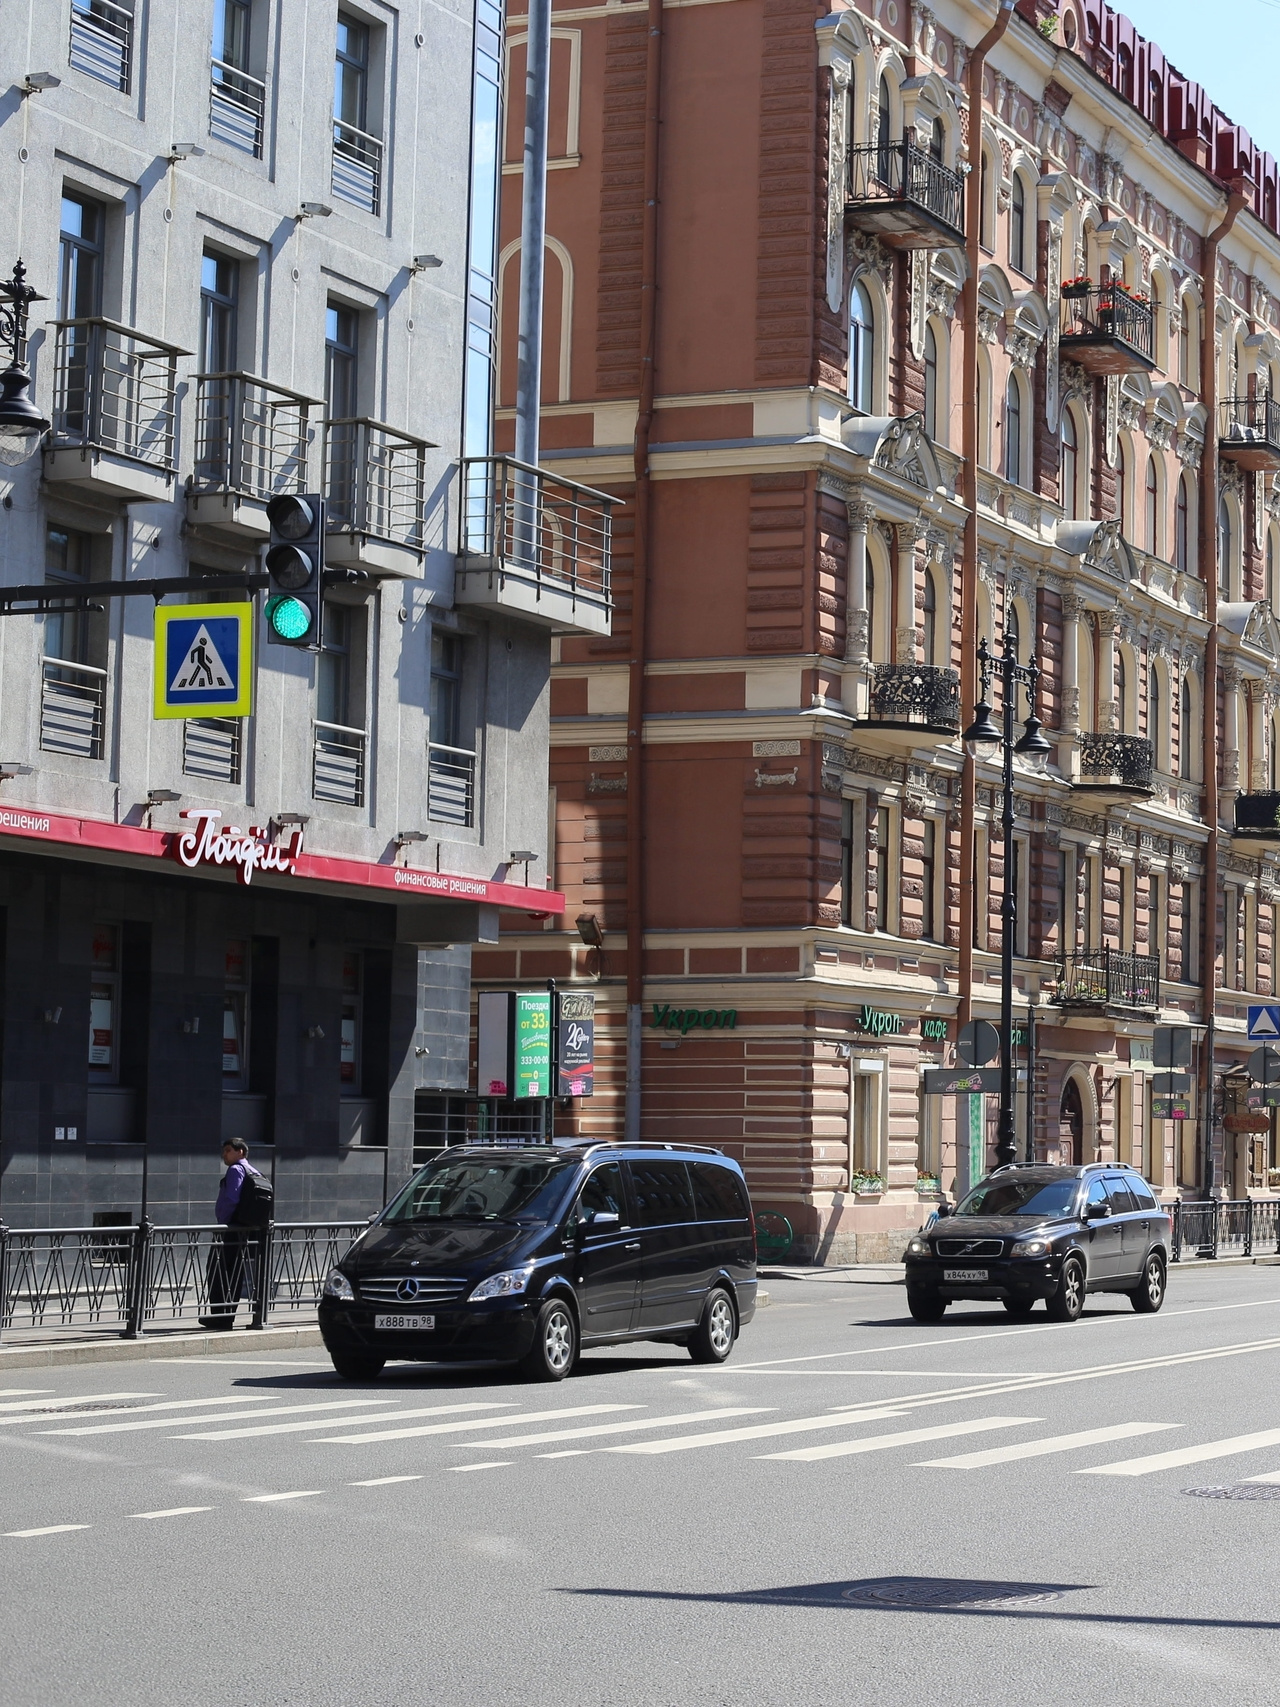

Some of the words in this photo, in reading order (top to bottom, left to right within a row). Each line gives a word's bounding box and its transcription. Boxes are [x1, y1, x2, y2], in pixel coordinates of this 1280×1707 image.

[180, 808, 303, 885] Пойдём!
[394, 869, 448, 890] финансовые
[449, 880, 487, 895] решения
[521, 1001, 549, 1011] Поездка
[521, 1021, 530, 1029] от
[531, 1013, 545, 1029] 33
[649, 1004, 737, 1035] Укроп
[862, 1005, 900, 1037] Укроп
[924, 1018, 947, 1042] кафе
[521, 1056, 549, 1065] 333-00-00
